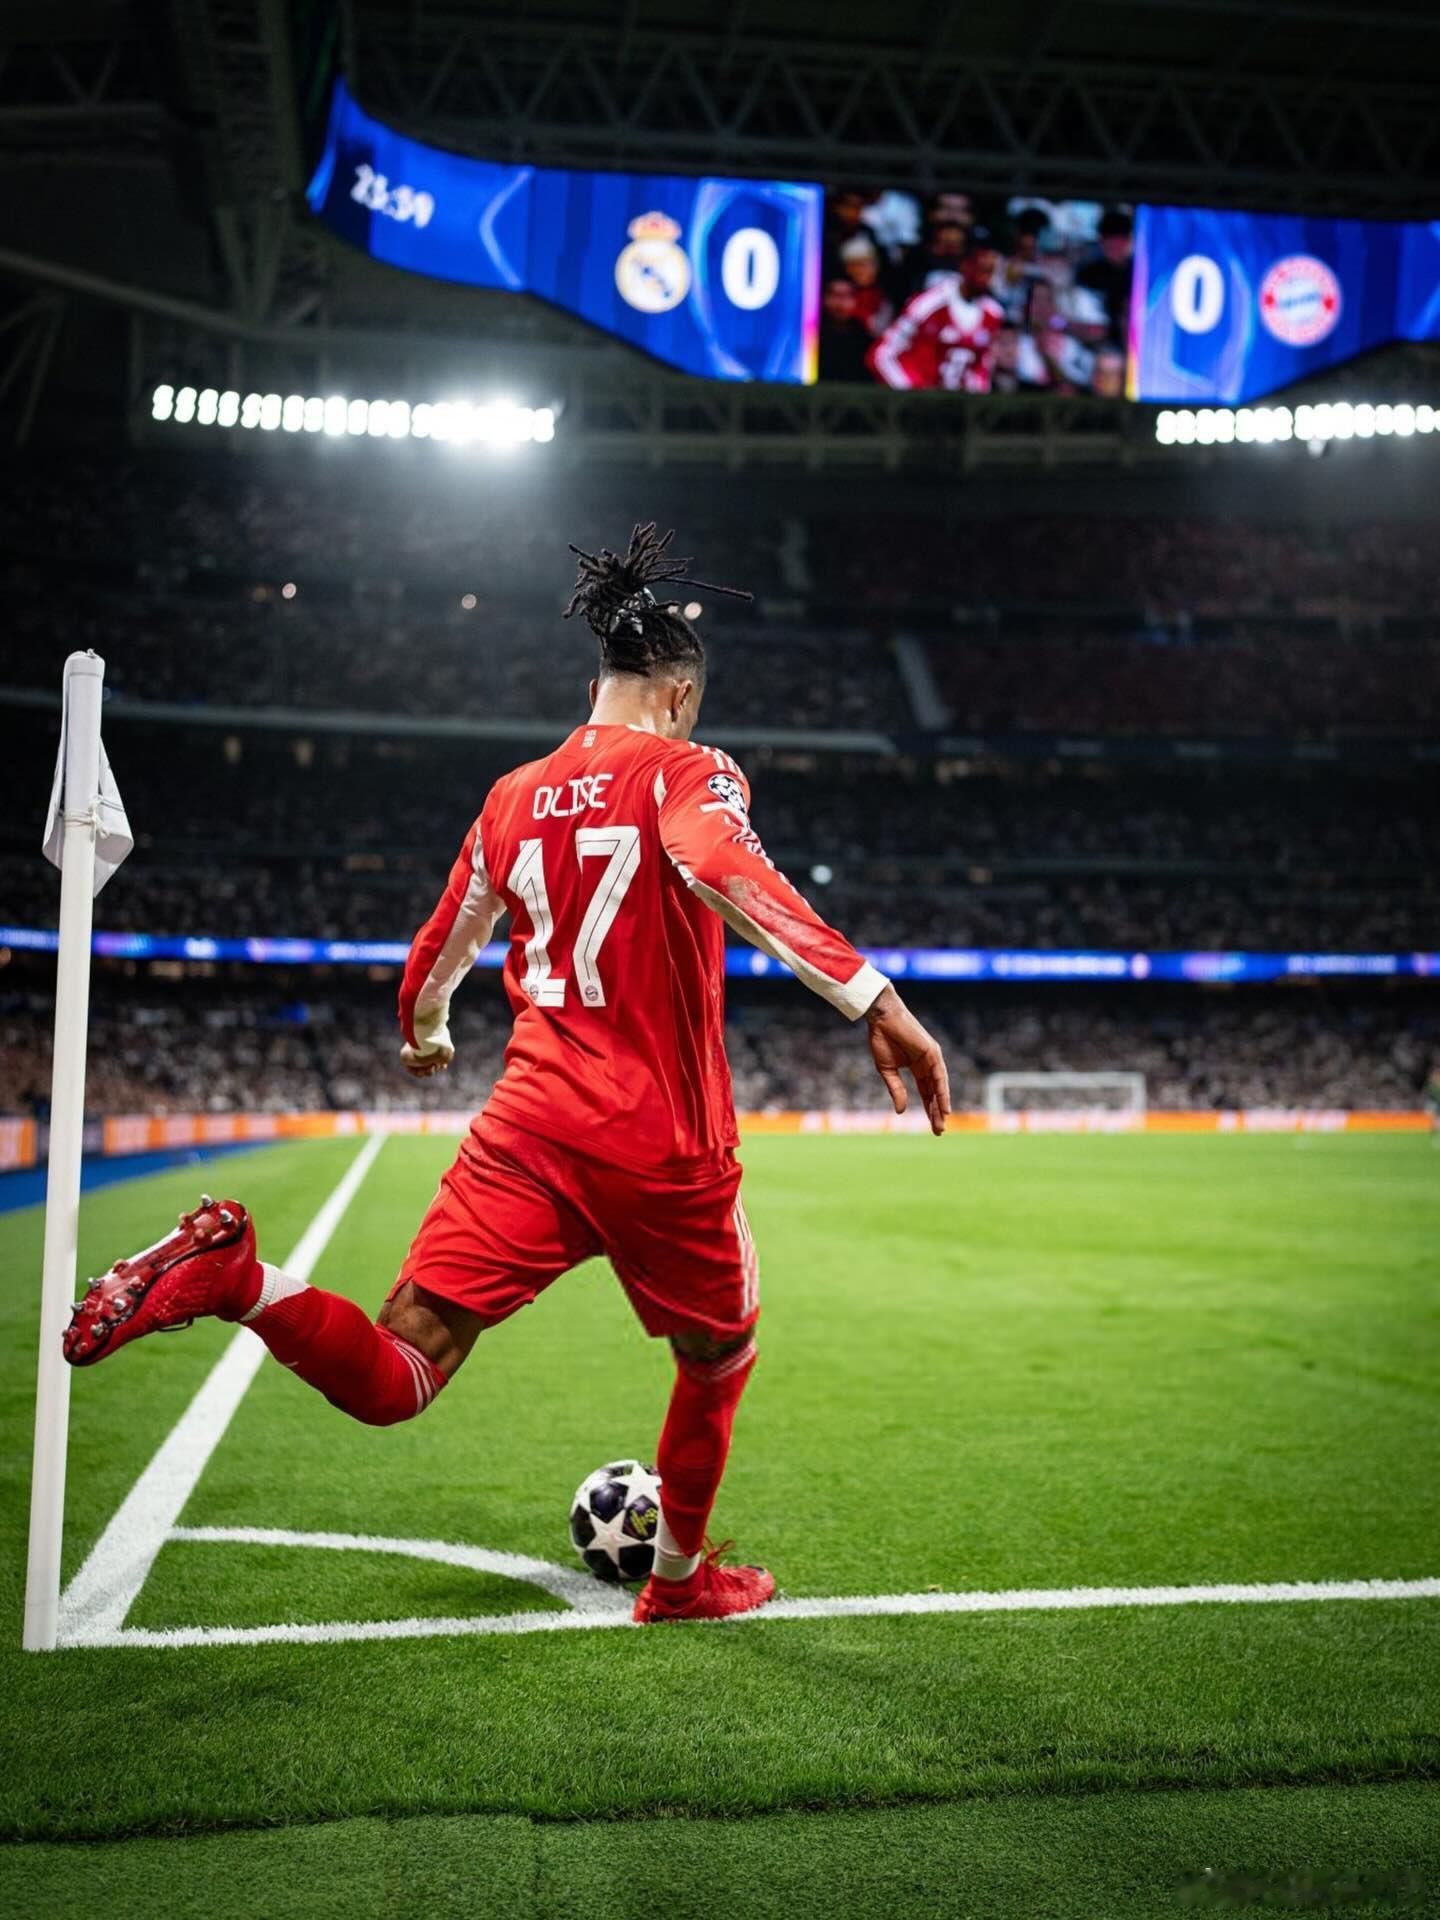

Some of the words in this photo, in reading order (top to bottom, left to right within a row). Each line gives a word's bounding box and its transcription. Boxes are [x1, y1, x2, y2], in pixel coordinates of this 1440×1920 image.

[721, 227, 780, 310] 0
[1171, 255, 1224, 334] 0
[532, 773, 613, 820] OLISE
[506, 825, 641, 1007] 17
